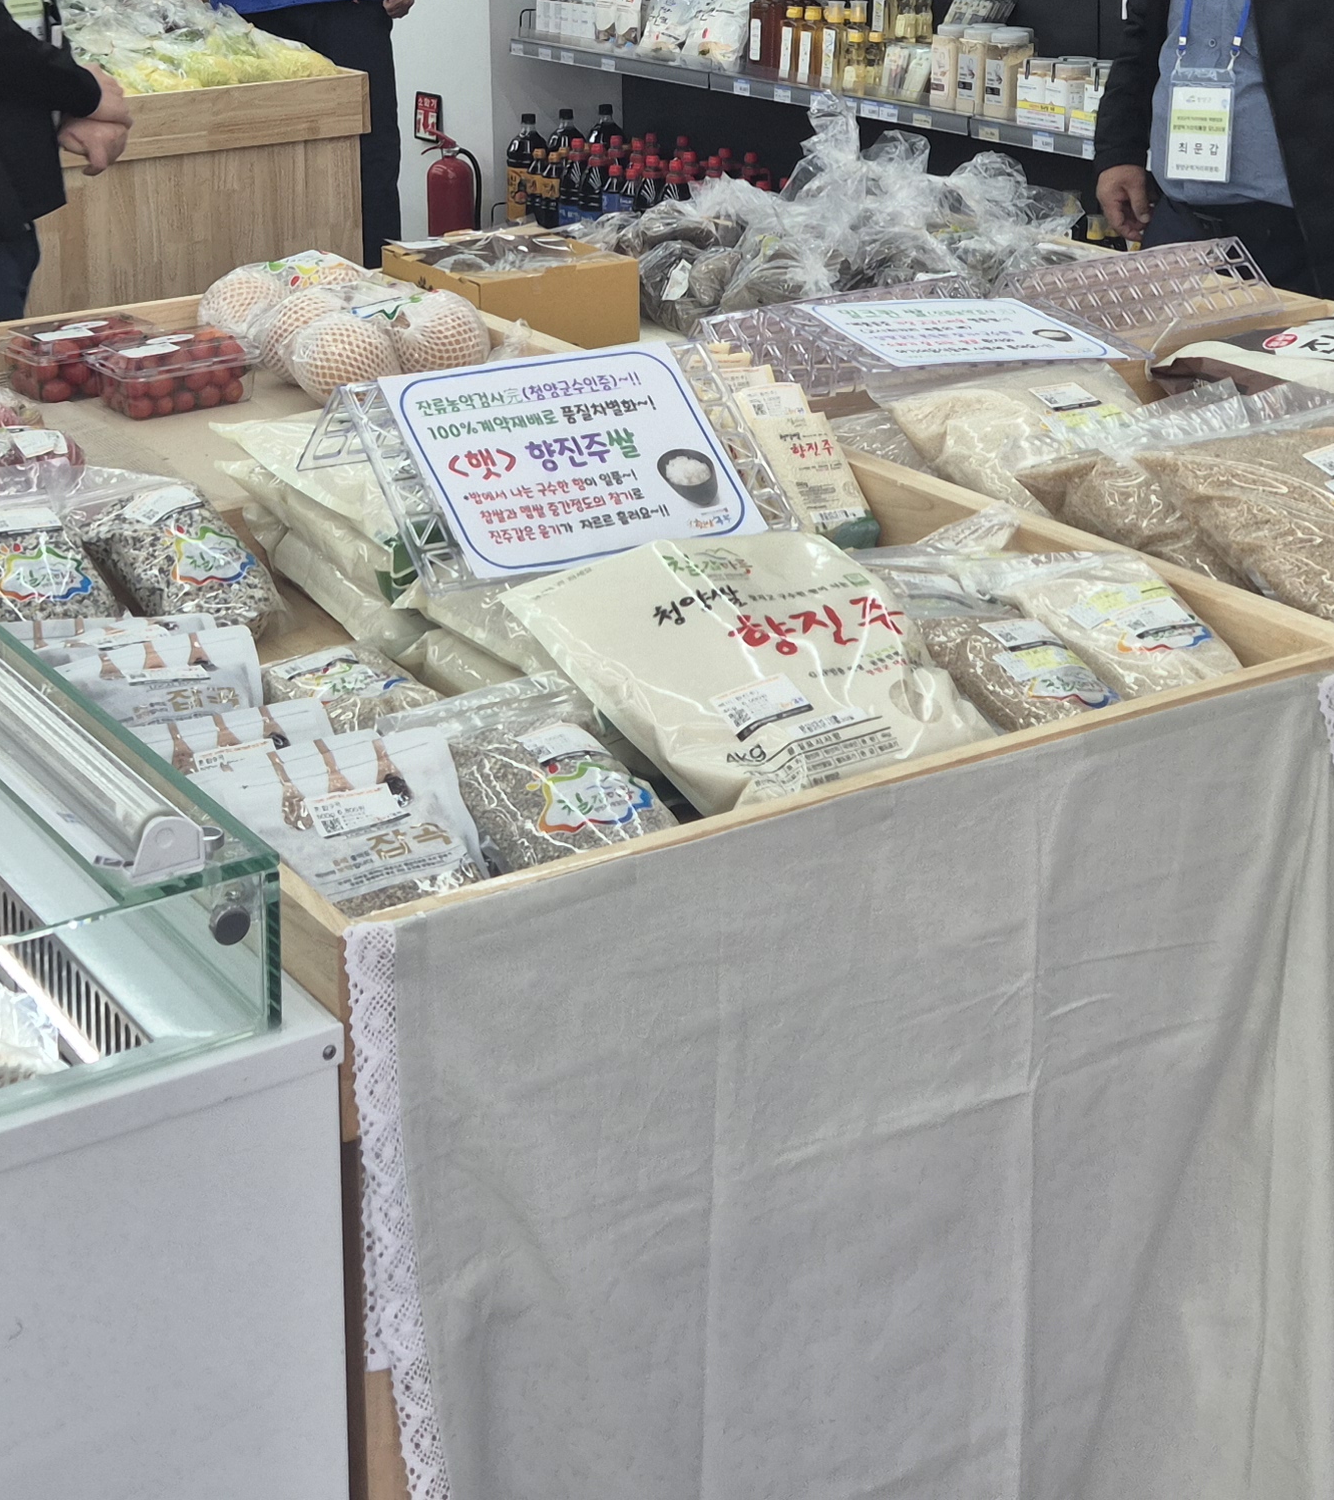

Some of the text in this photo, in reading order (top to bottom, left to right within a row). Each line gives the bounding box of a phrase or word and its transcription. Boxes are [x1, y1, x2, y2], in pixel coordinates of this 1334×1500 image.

[427, 394, 657, 441] 100%계약재배로 품질차별화~!
[447, 426, 642, 482] <햇> 향진주쌀
[789, 438, 835, 460] 향진주
[479, 506, 518, 526] 찹쌀과
[547, 494, 607, 518] 중간정도의
[607, 487, 646, 508] 찰기로
[508, 484, 535, 500] 나는
[536, 480, 571, 498] 구수한
[571, 474, 599, 495] 향이
[487, 522, 537, 546] 진주같은
[537, 518, 575, 540] 윤기가
[579, 514, 616, 532] 자르르
[653, 585, 748, 627] 청양쌀
[727, 594, 905, 657] 향진주
[726, 743, 768, 765] 4kg
